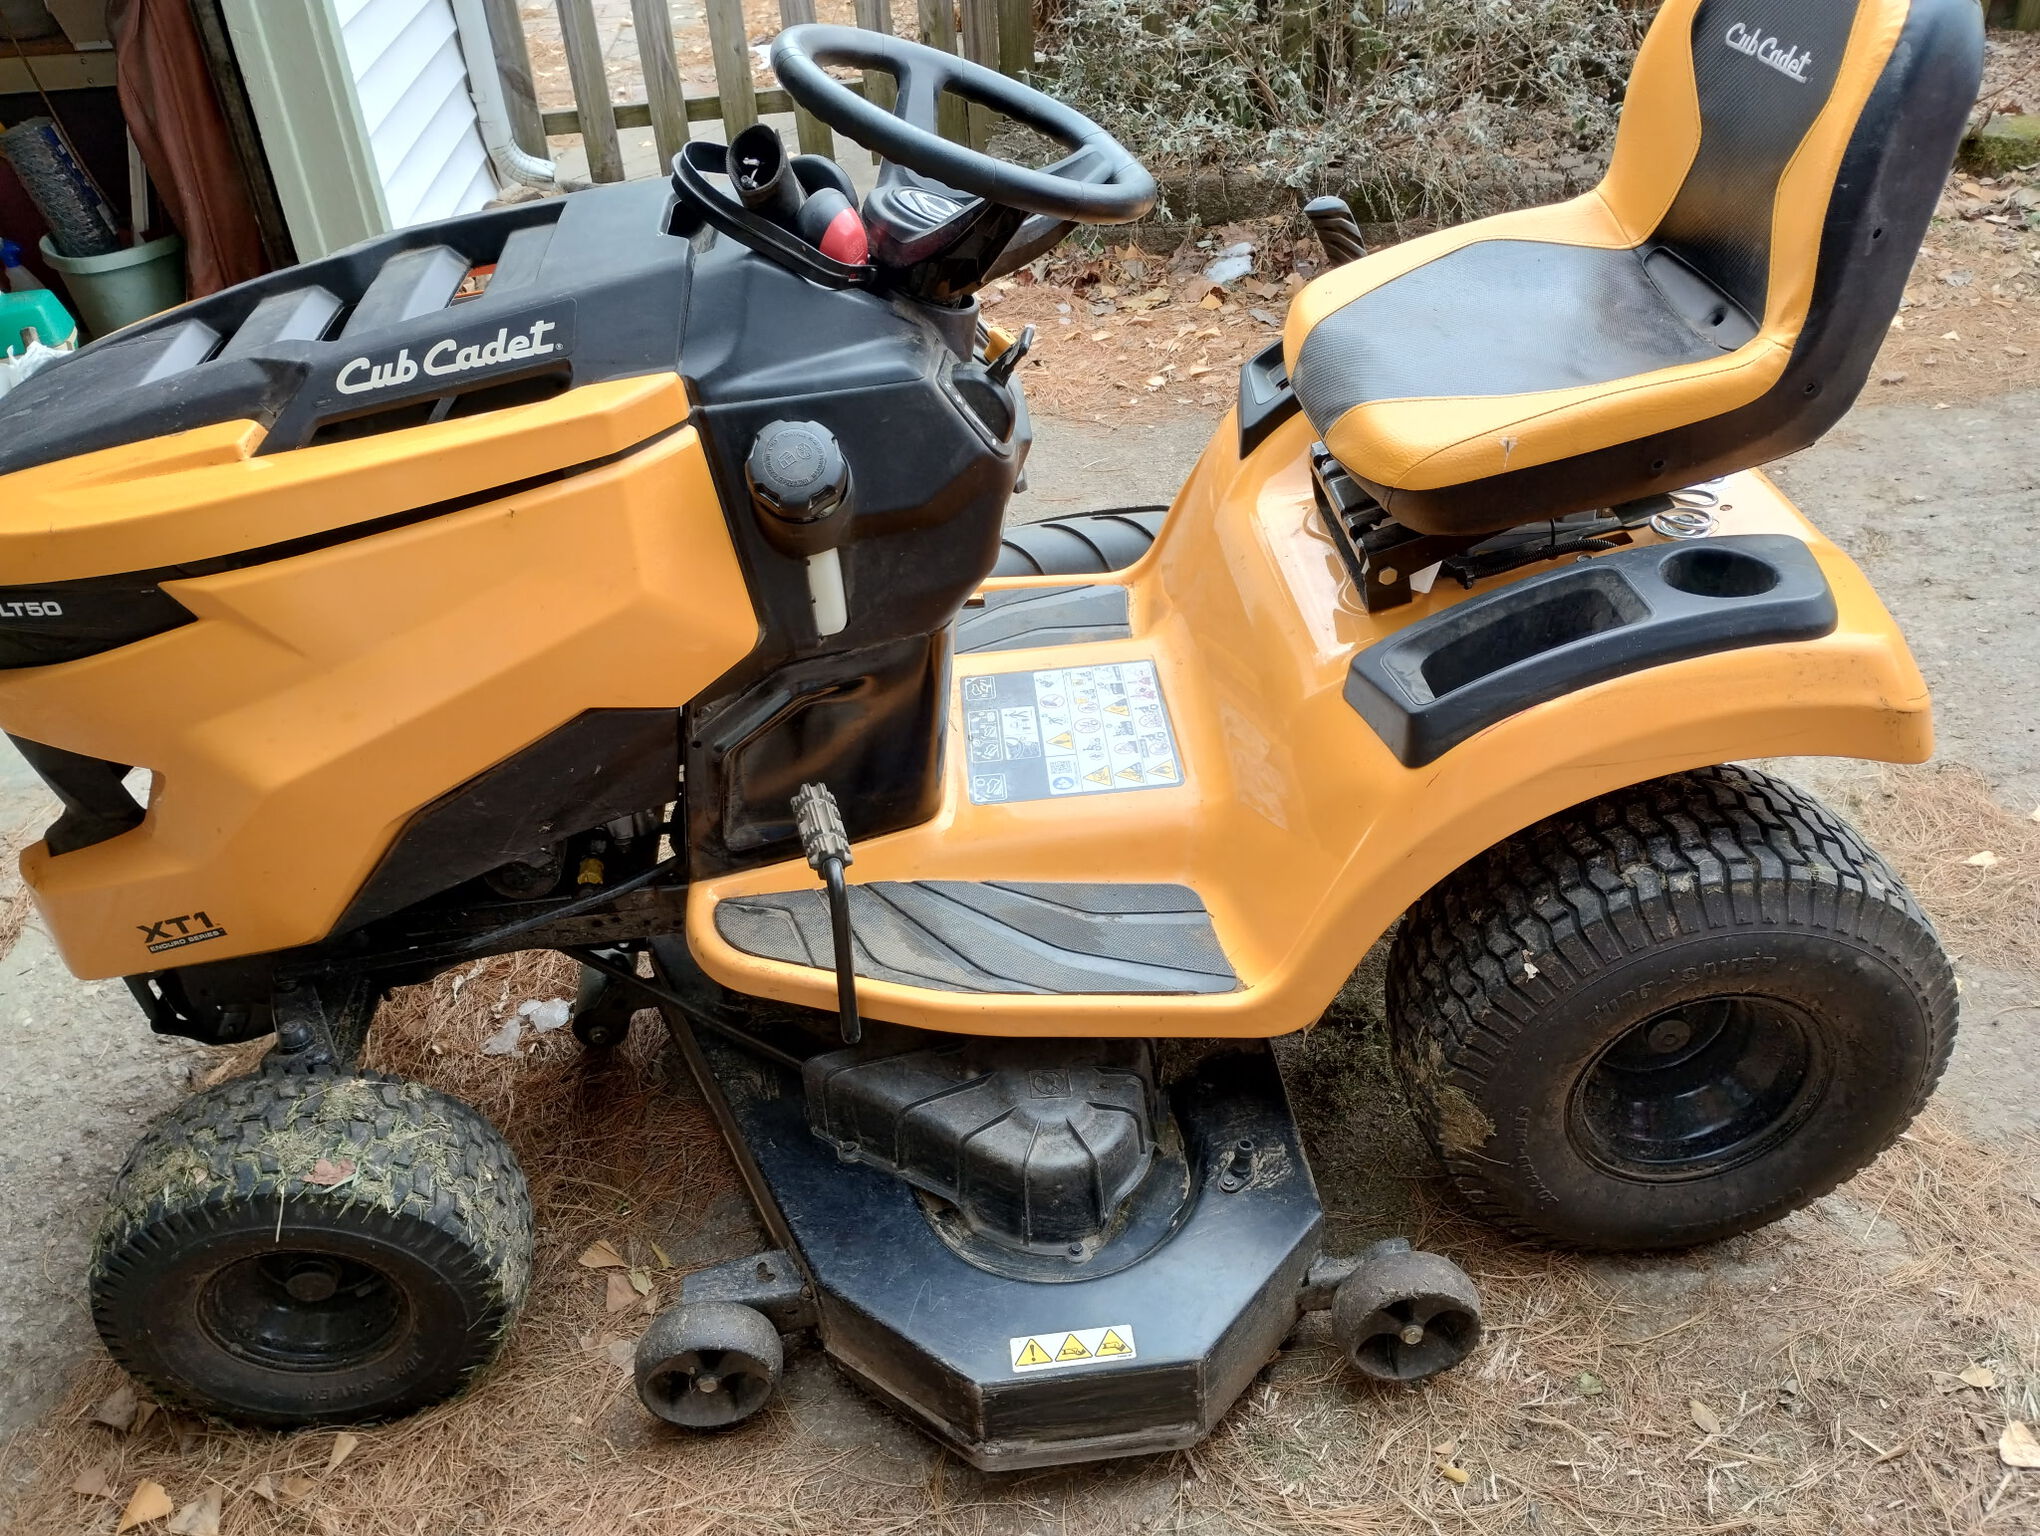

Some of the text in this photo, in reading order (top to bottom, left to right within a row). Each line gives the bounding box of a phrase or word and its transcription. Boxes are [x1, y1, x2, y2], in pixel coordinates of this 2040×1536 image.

[1725, 22, 1812, 84] Cub Cadet
[335, 319, 556, 395] Cub Cadet
[0, 601, 63, 617] LT50
[136, 911, 214, 944] XT1
[149, 929, 221, 952] ENDURO SERIES
